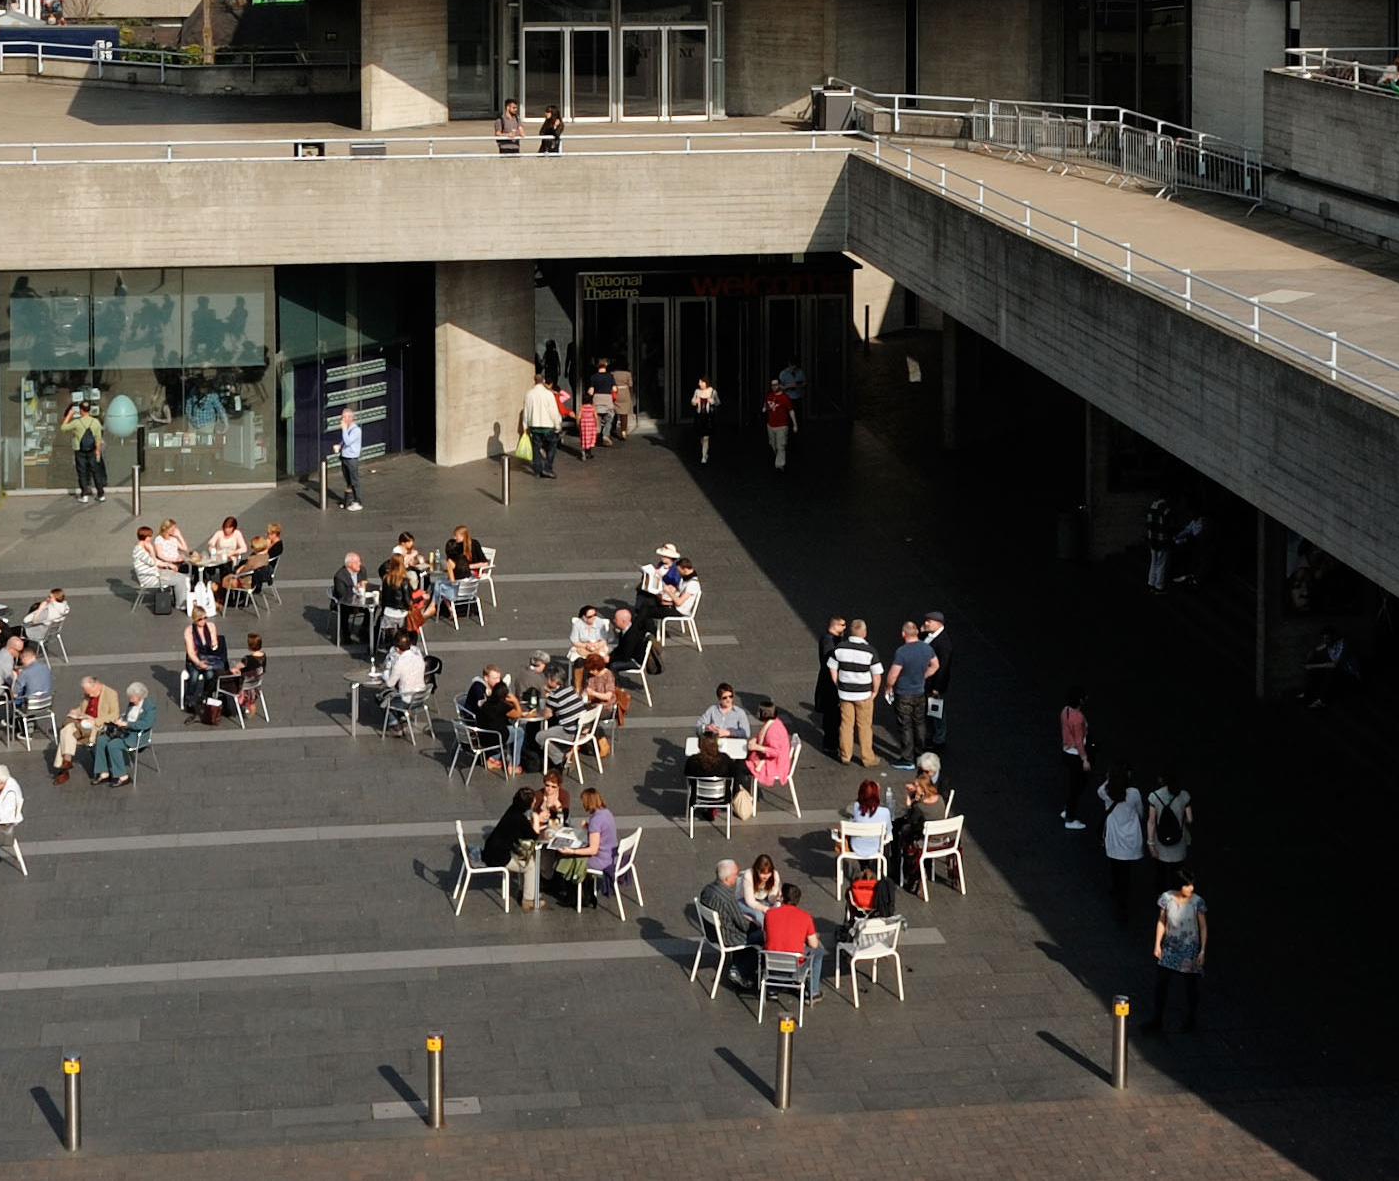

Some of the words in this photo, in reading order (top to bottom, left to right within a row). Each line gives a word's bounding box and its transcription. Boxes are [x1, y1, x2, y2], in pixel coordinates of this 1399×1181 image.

[584, 275, 643, 287] National
[690, 271, 848, 297] welcome
[584, 286, 640, 299] Theatre
